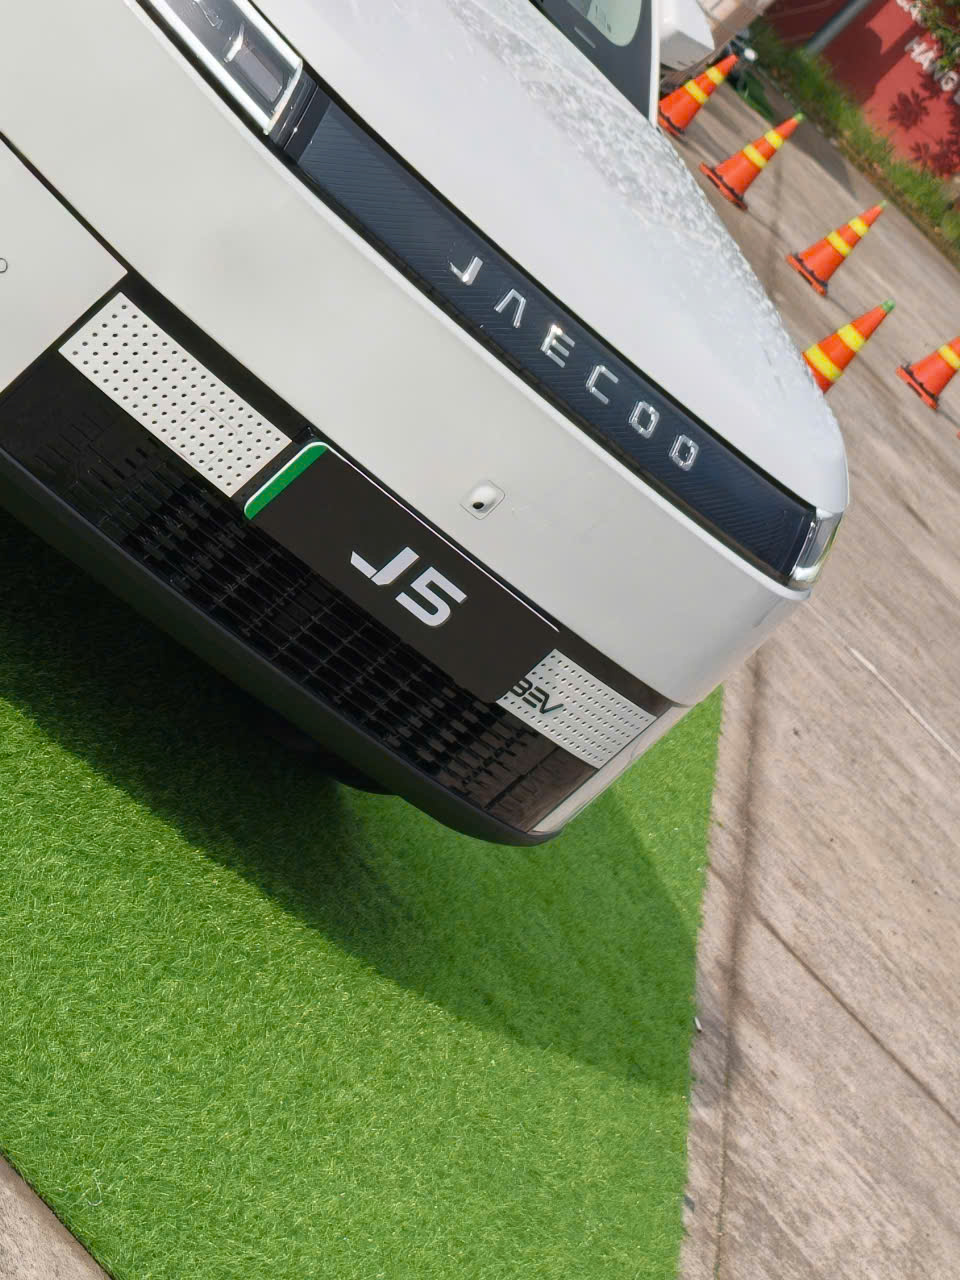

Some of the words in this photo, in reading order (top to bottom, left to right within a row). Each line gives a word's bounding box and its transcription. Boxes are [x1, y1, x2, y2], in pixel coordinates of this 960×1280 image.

[449, 255, 700, 472] JAECOO
[350, 546, 467, 627] J5
[510, 677, 564, 714] BEV
